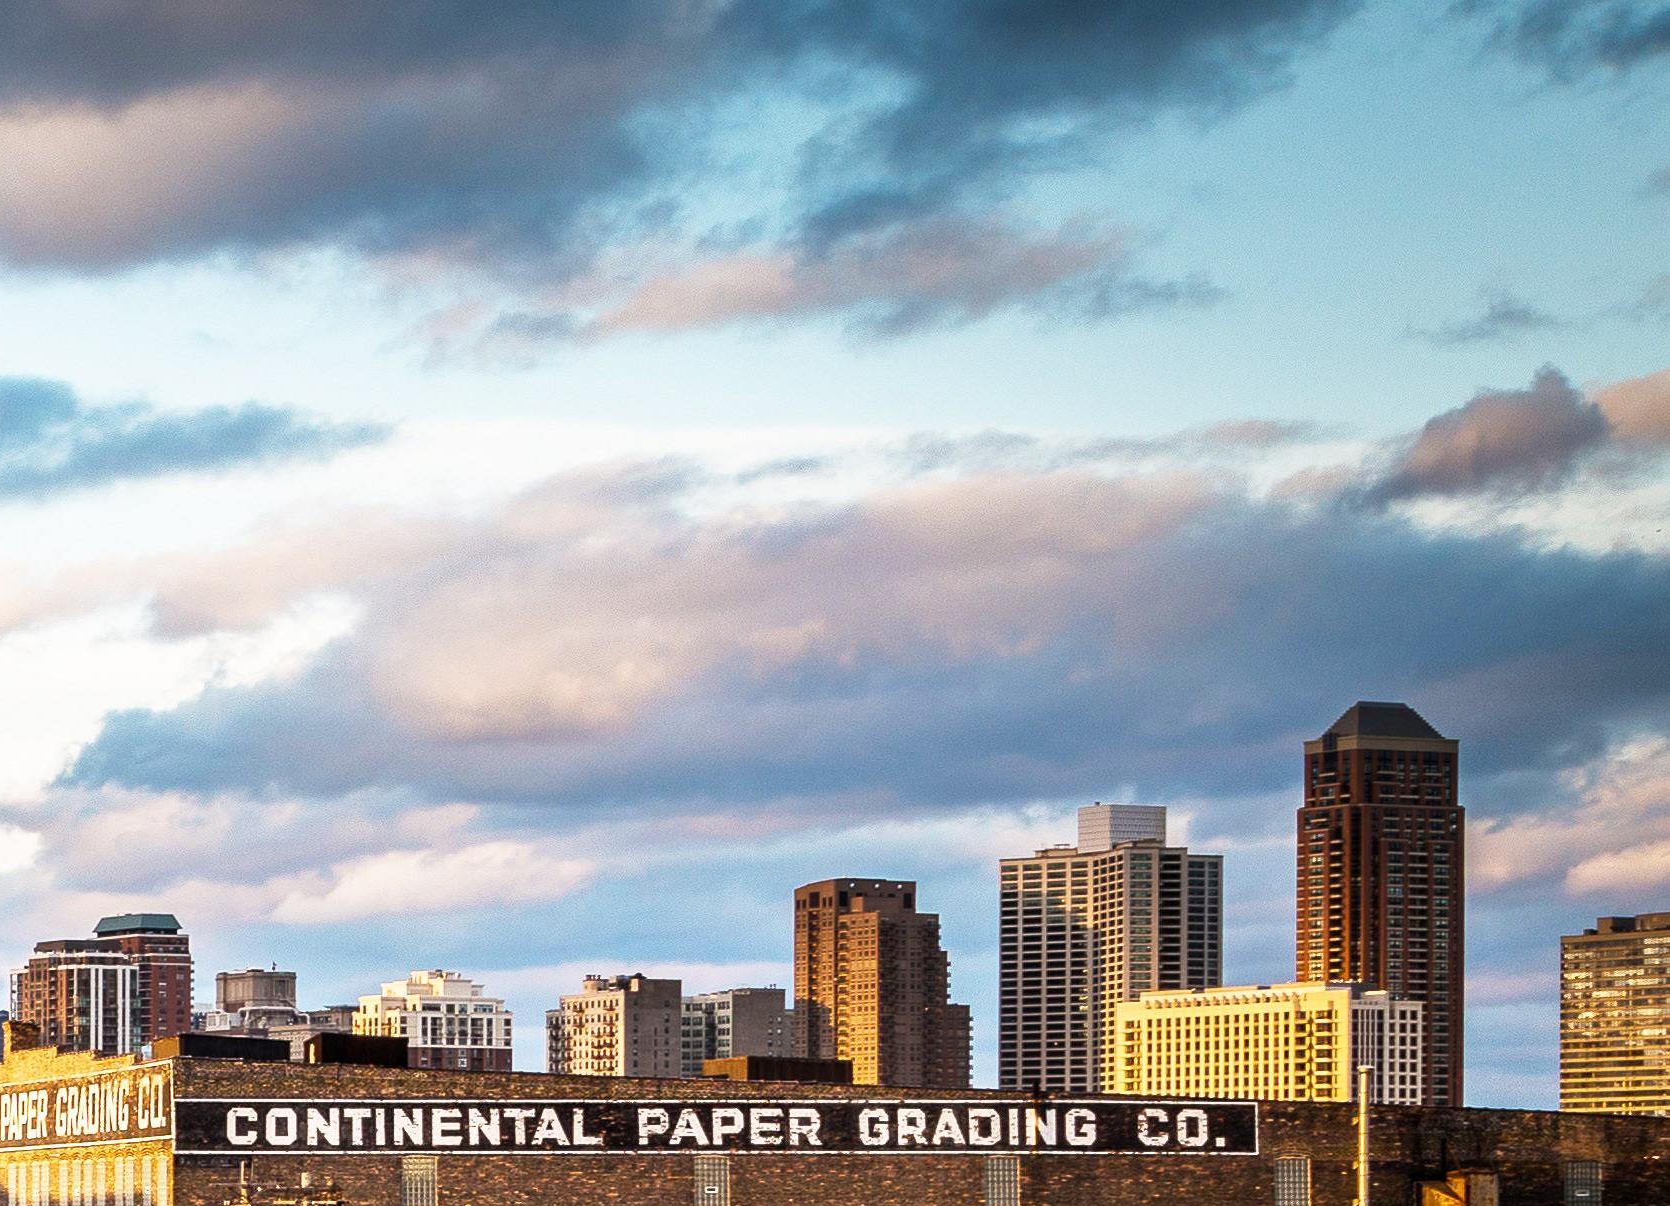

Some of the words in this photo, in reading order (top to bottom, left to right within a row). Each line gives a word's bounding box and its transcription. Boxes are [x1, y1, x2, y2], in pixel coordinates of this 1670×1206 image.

[0, 1090, 48, 1142] PAPER
[55, 1079, 130, 1137] GRADING
[137, 1074, 167, 1130] CO.
[225, 1107, 603, 1146] CONTINENTAL
[637, 1107, 823, 1146] PAPER
[858, 1107, 1097, 1147] GRADING
[1137, 1108, 1226, 1148] CO.
